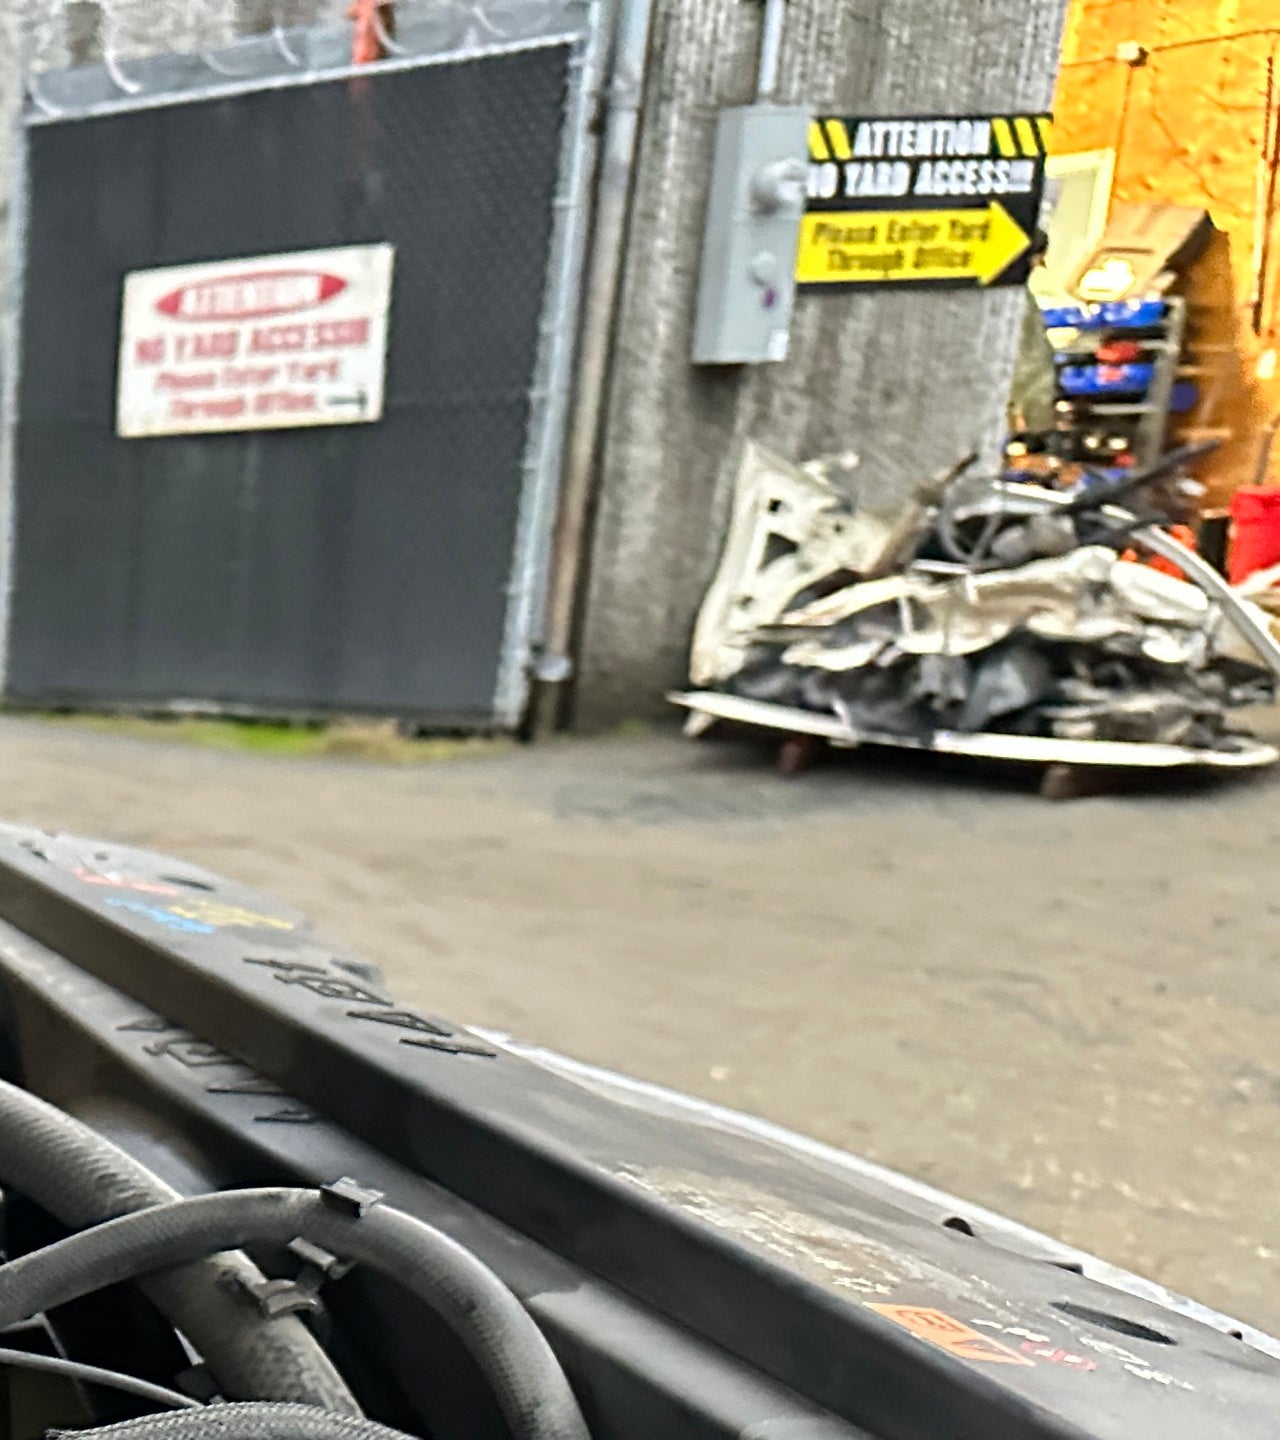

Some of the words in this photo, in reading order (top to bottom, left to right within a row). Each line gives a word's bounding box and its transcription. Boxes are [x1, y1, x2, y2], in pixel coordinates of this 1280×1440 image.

[853, 120, 990, 157] ATTENTION
[844, 160, 911, 197] YARD
[812, 221, 878, 246] Please
[886, 218, 941, 245] Enter
[948, 217, 991, 243] Yard
[826, 248, 904, 277] Through
[913, 246, 971, 270] Office
[134, 336, 164, 364] NO
[174, 330, 239, 362] YARD
[221, 364, 279, 387] Enter
[286, 359, 340, 383] Yard
